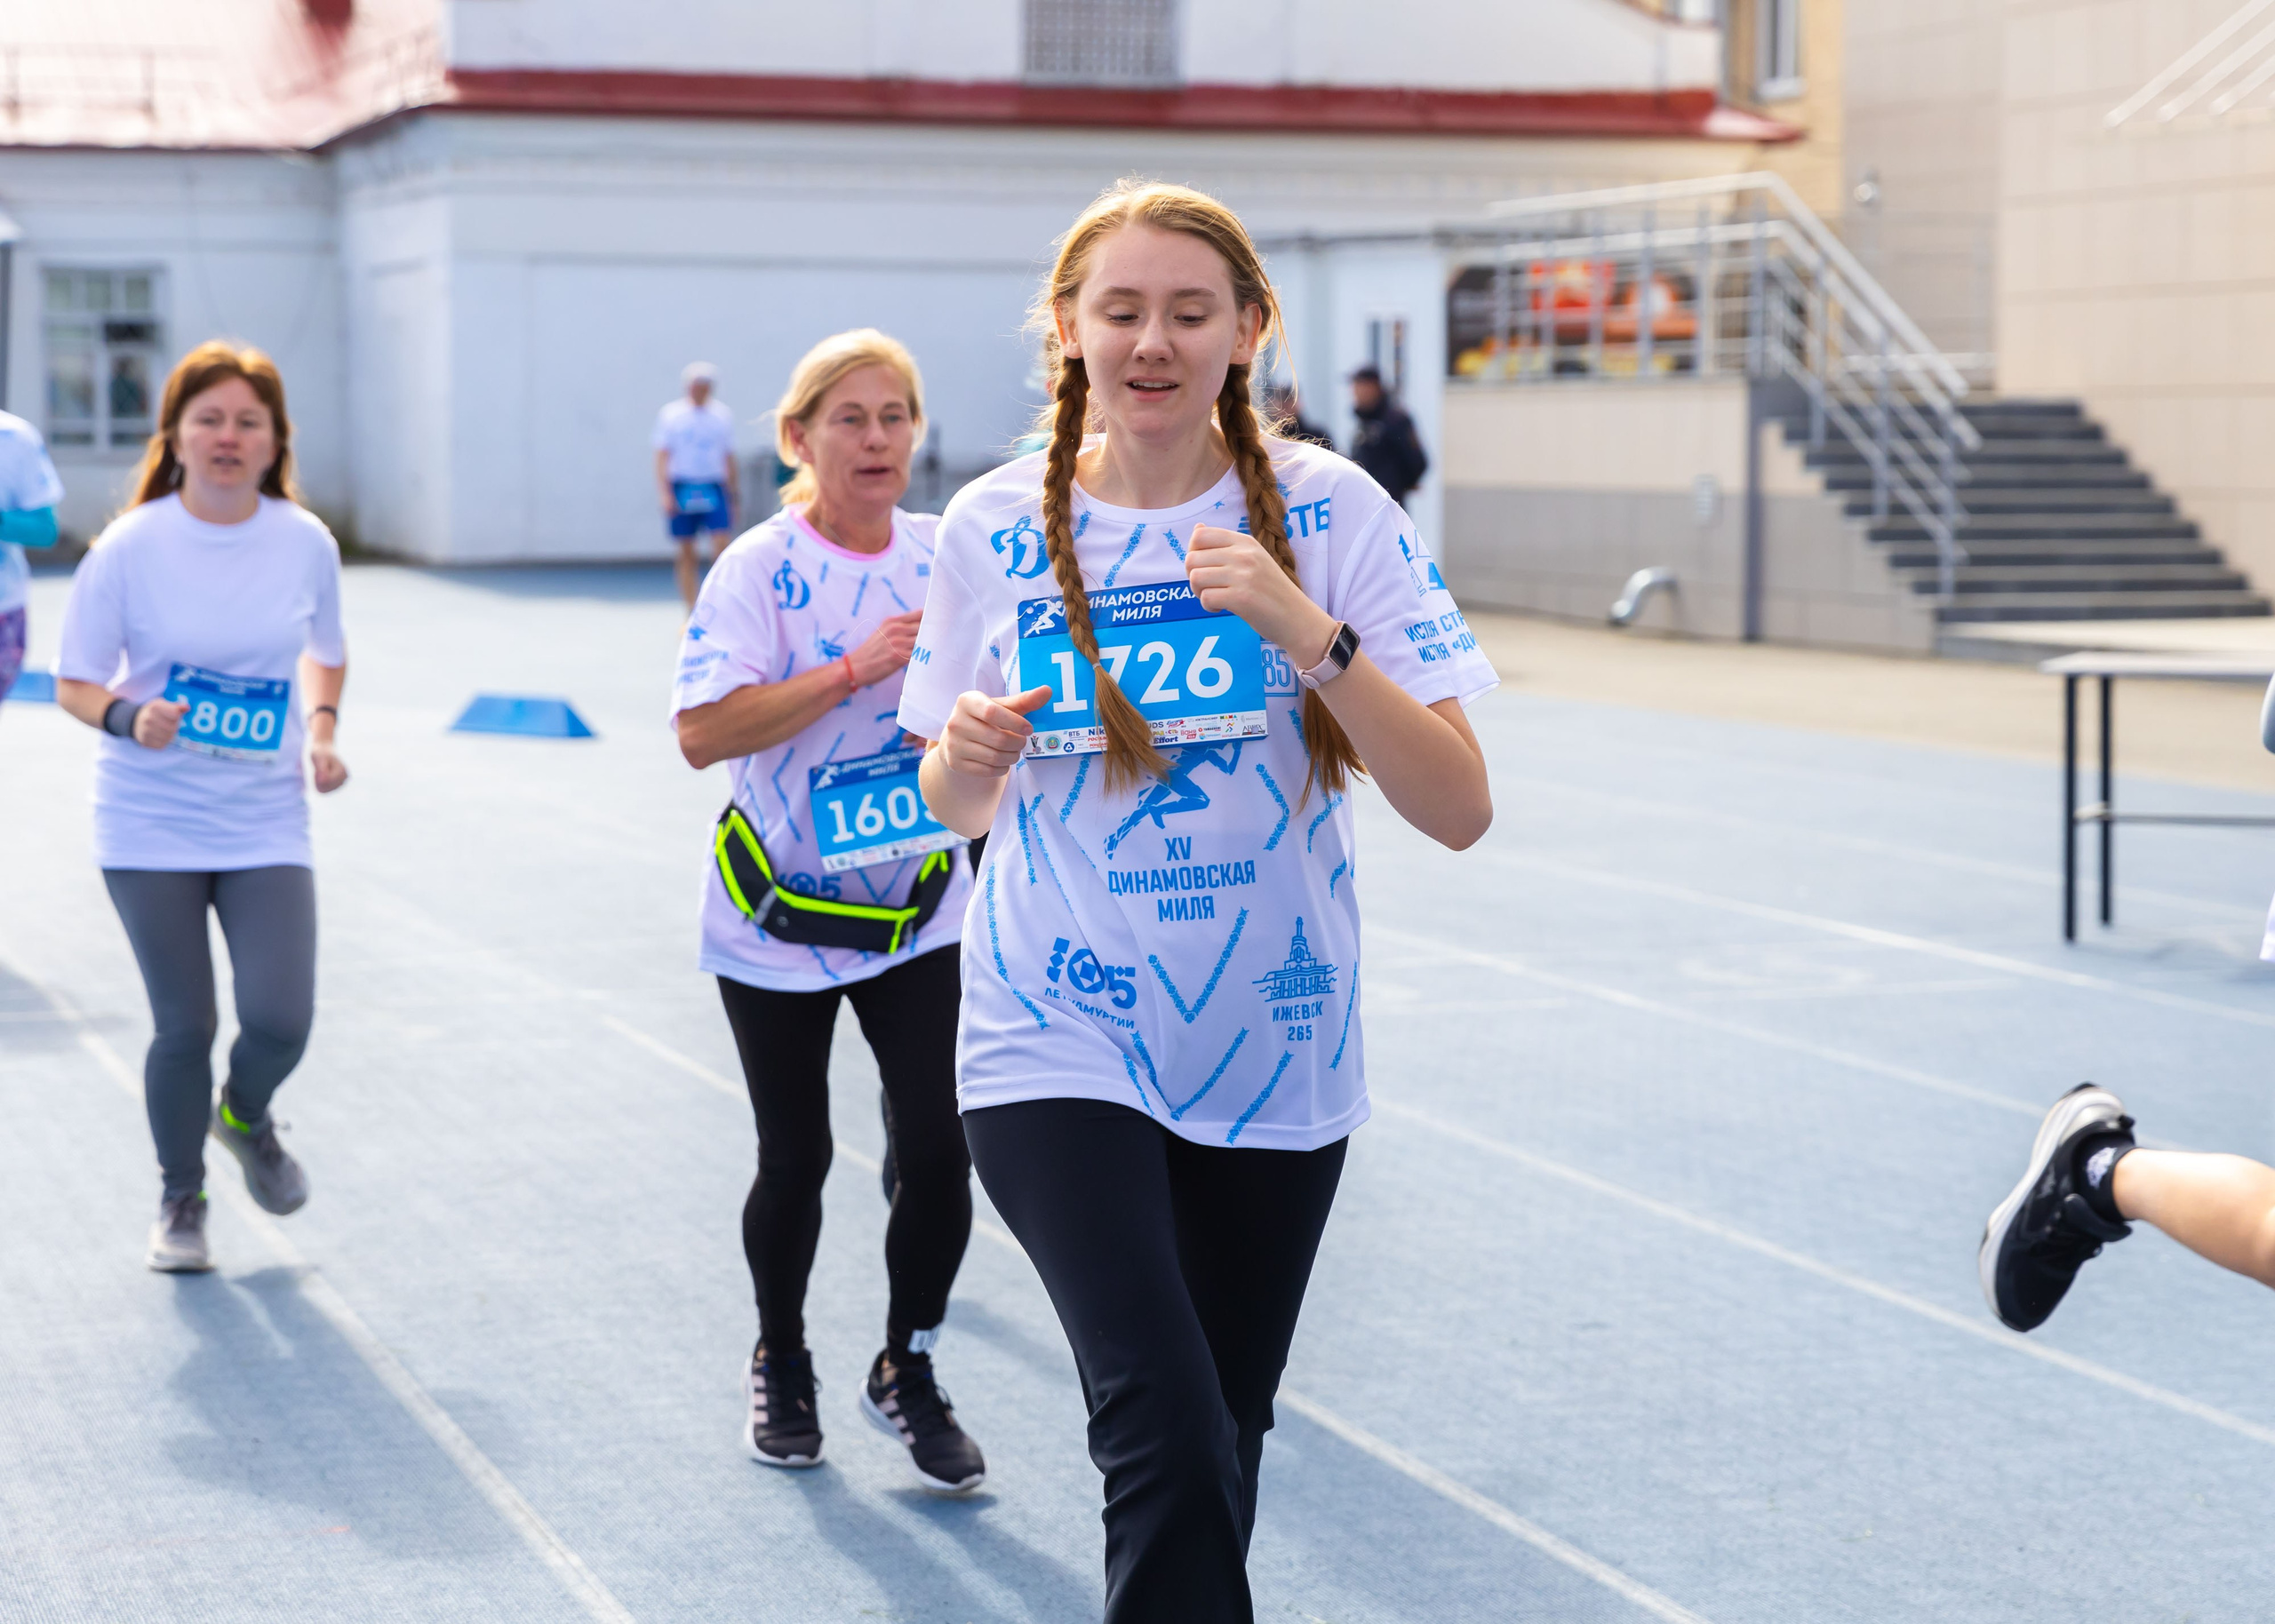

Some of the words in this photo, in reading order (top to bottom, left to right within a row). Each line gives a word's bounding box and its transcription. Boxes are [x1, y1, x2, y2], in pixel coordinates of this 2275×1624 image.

[1112, 605, 1162, 622] МИЛЯ
[1051, 635, 1233, 713] 1726
[1164, 836, 1192, 861] XV
[1108, 860, 1256, 896] ДИНАМОВСКАЯ
[1157, 896, 1216, 922] МИЛЯ
[1068, 997, 1135, 1030] ДМУРТИИ
[1273, 1000, 1323, 1023] ИЖЕВСК
[1287, 1024, 1312, 1041] 265
